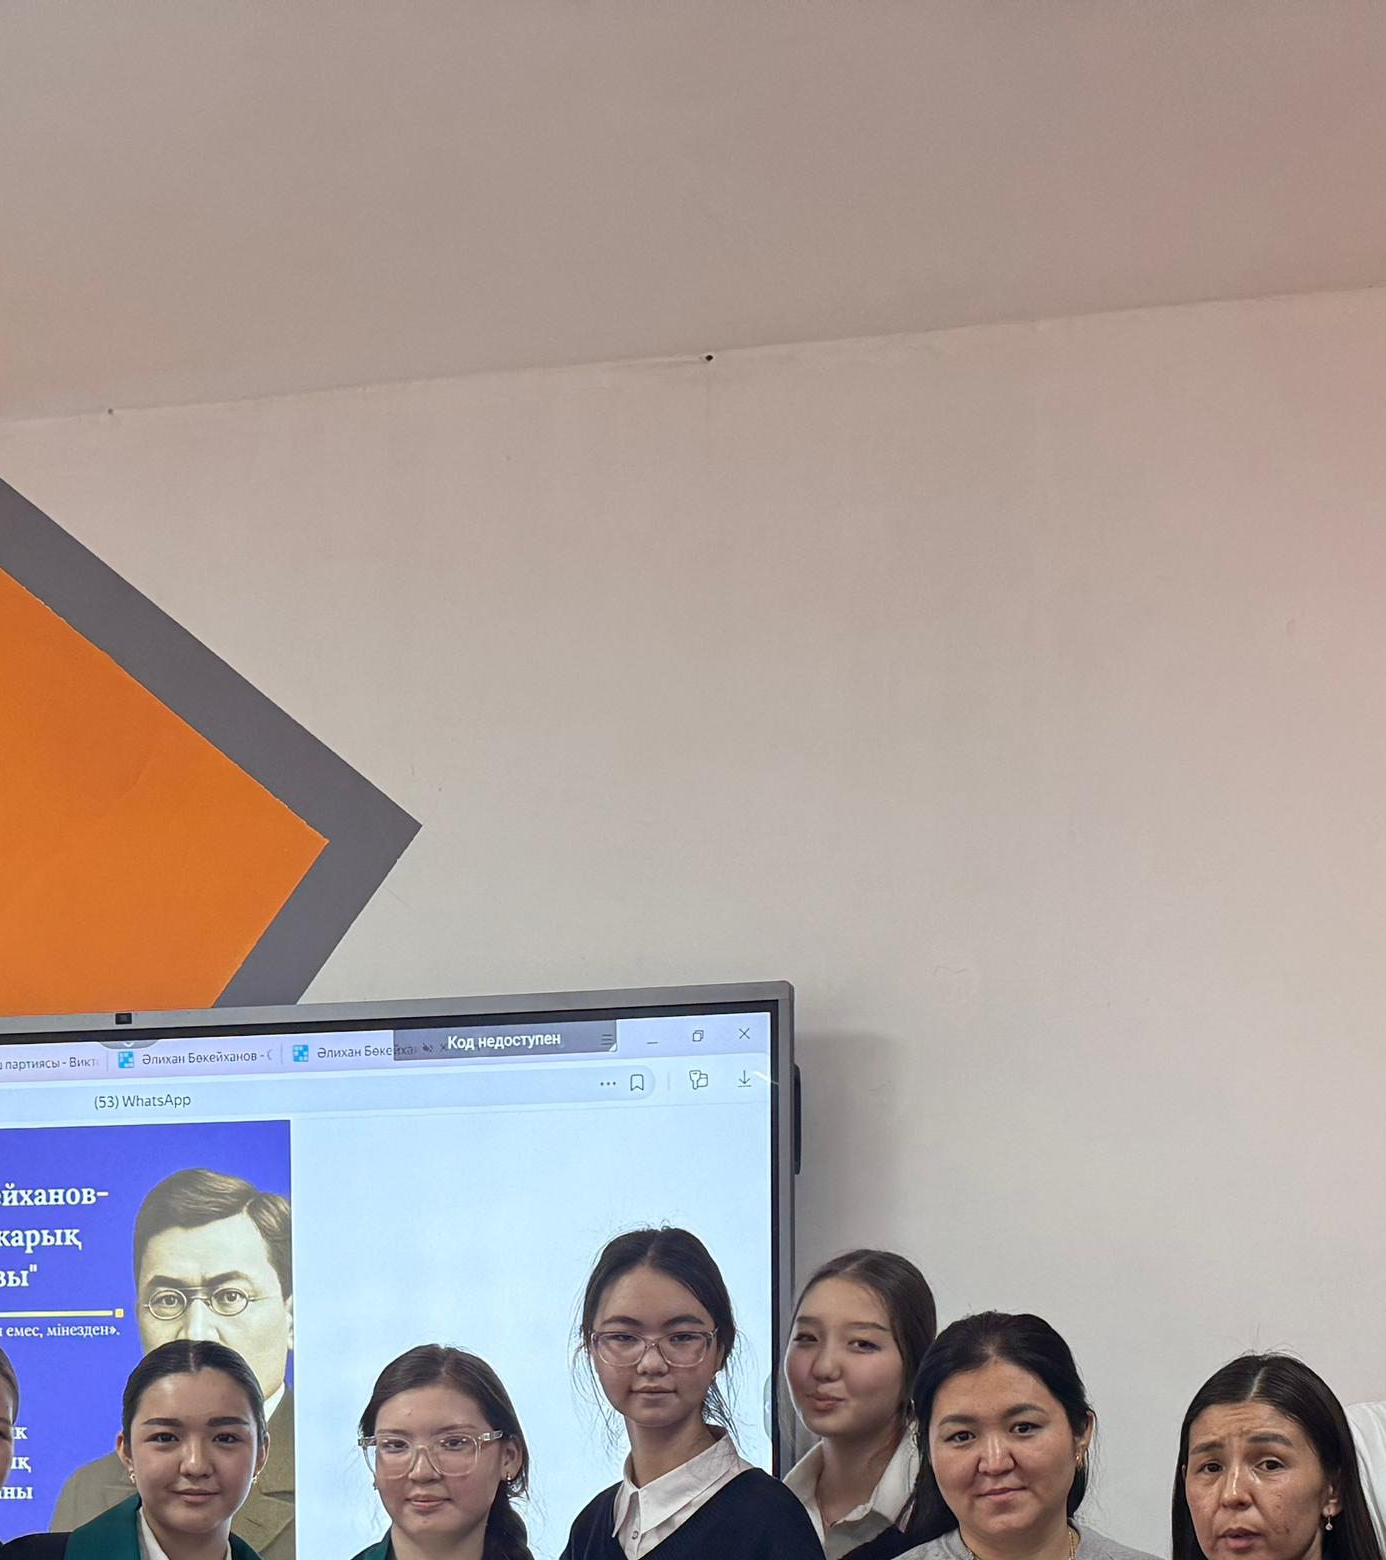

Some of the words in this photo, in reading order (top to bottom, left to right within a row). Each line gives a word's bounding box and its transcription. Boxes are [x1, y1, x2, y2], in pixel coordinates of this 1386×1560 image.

[448, 1035, 475, 1051] Код
[478, 1033, 561, 1050] недоступен
[5, 1058, 60, 1072] партиясы
[142, 1053, 186, 1066] Әлихан
[188, 1050, 257, 1064] Бөкейханов
[94, 1095, 119, 1110] (53)
[121, 1093, 192, 1109] WhatsApp
[6, 1327, 44, 1339] емес,
